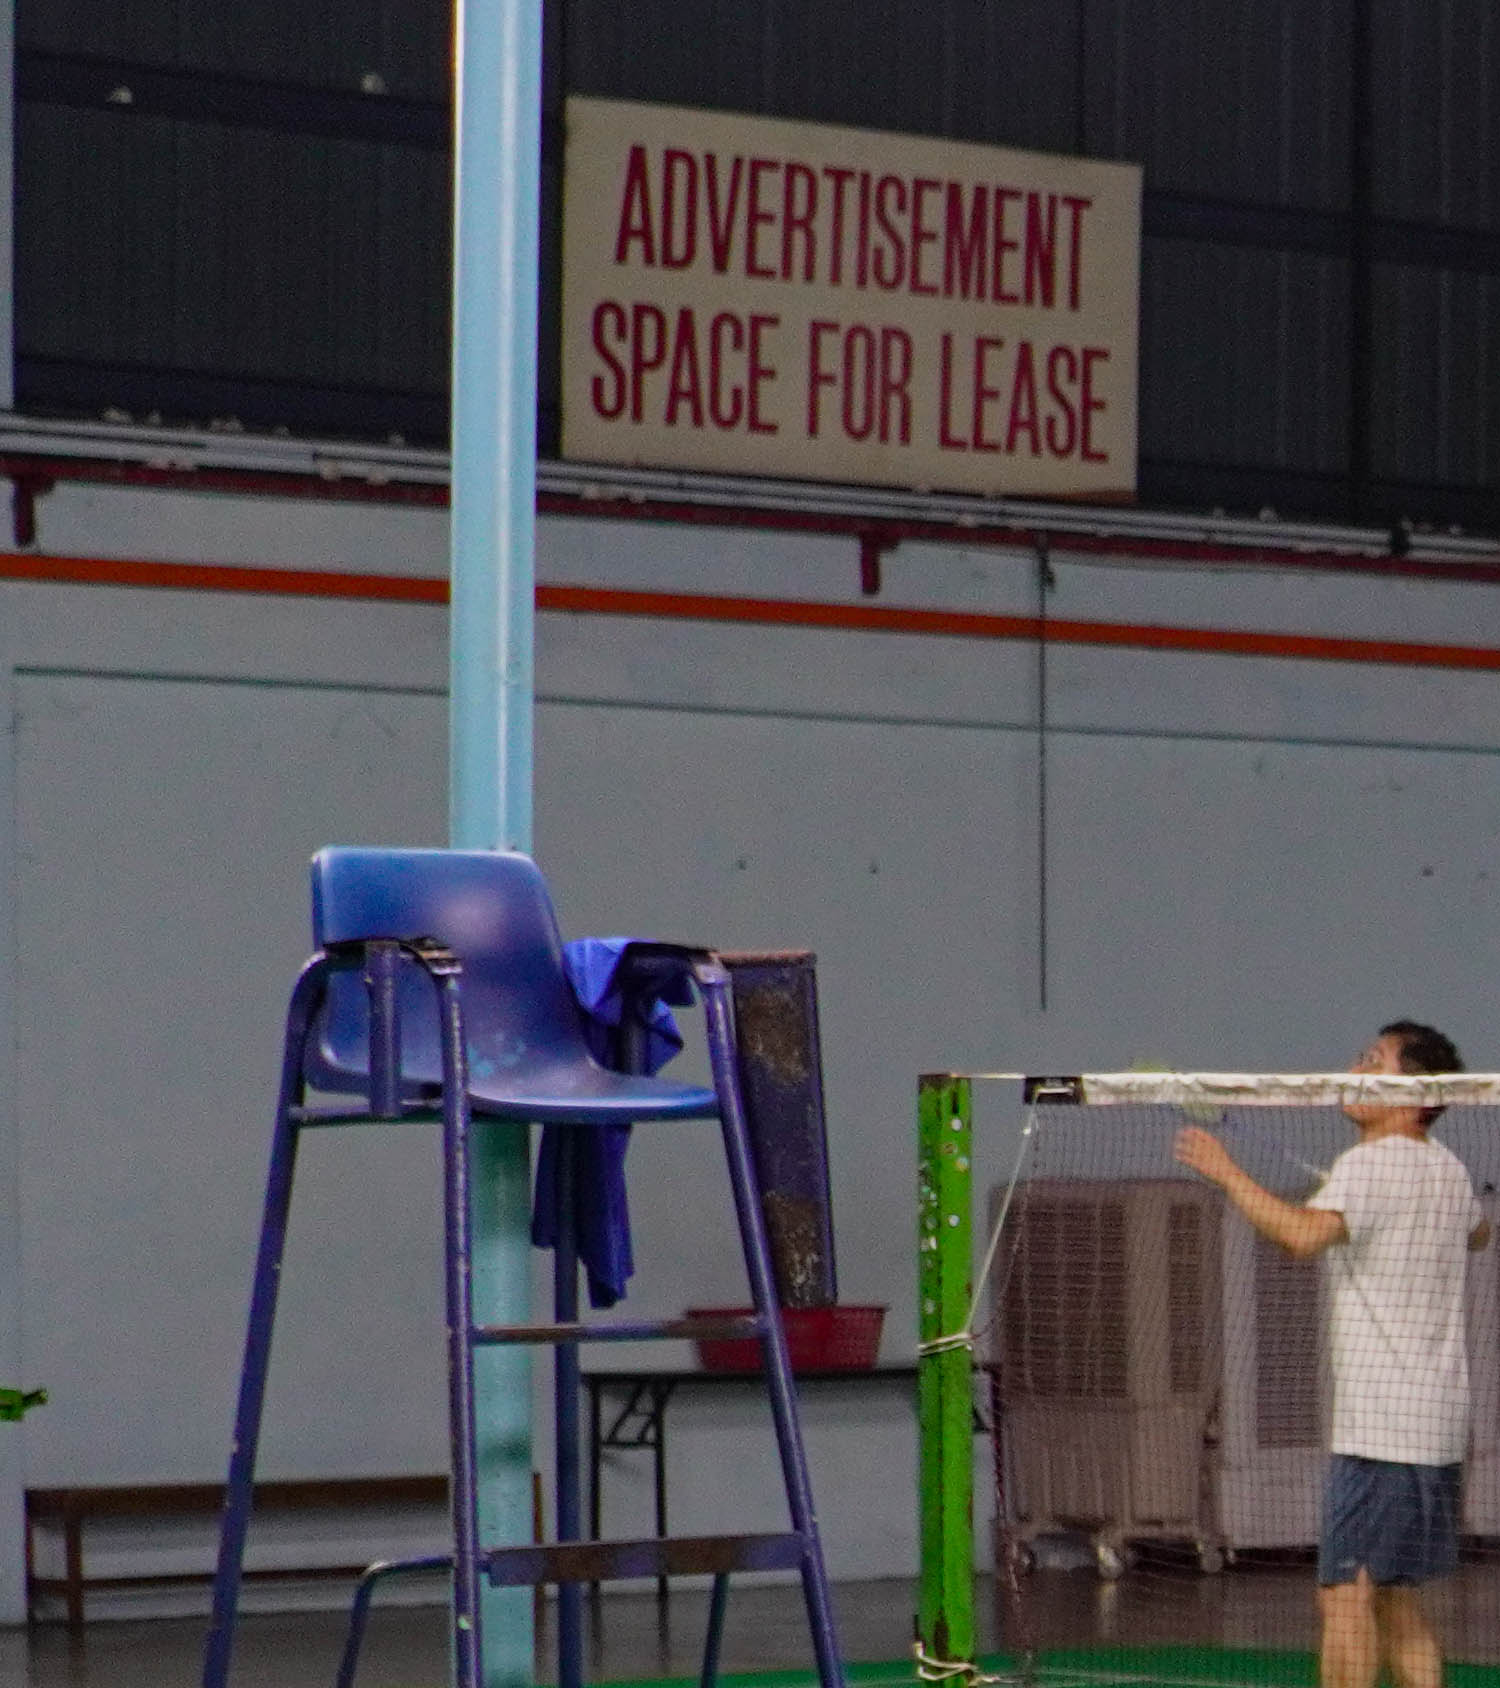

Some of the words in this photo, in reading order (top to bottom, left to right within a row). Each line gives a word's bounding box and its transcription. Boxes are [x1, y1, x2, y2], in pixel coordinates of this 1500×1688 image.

[615, 144, 1093, 312] ADVERTISEMENT
[591, 300, 780, 436] SPACE
[806, 320, 913, 447] FOR
[938, 332, 1111, 465] LEASE
